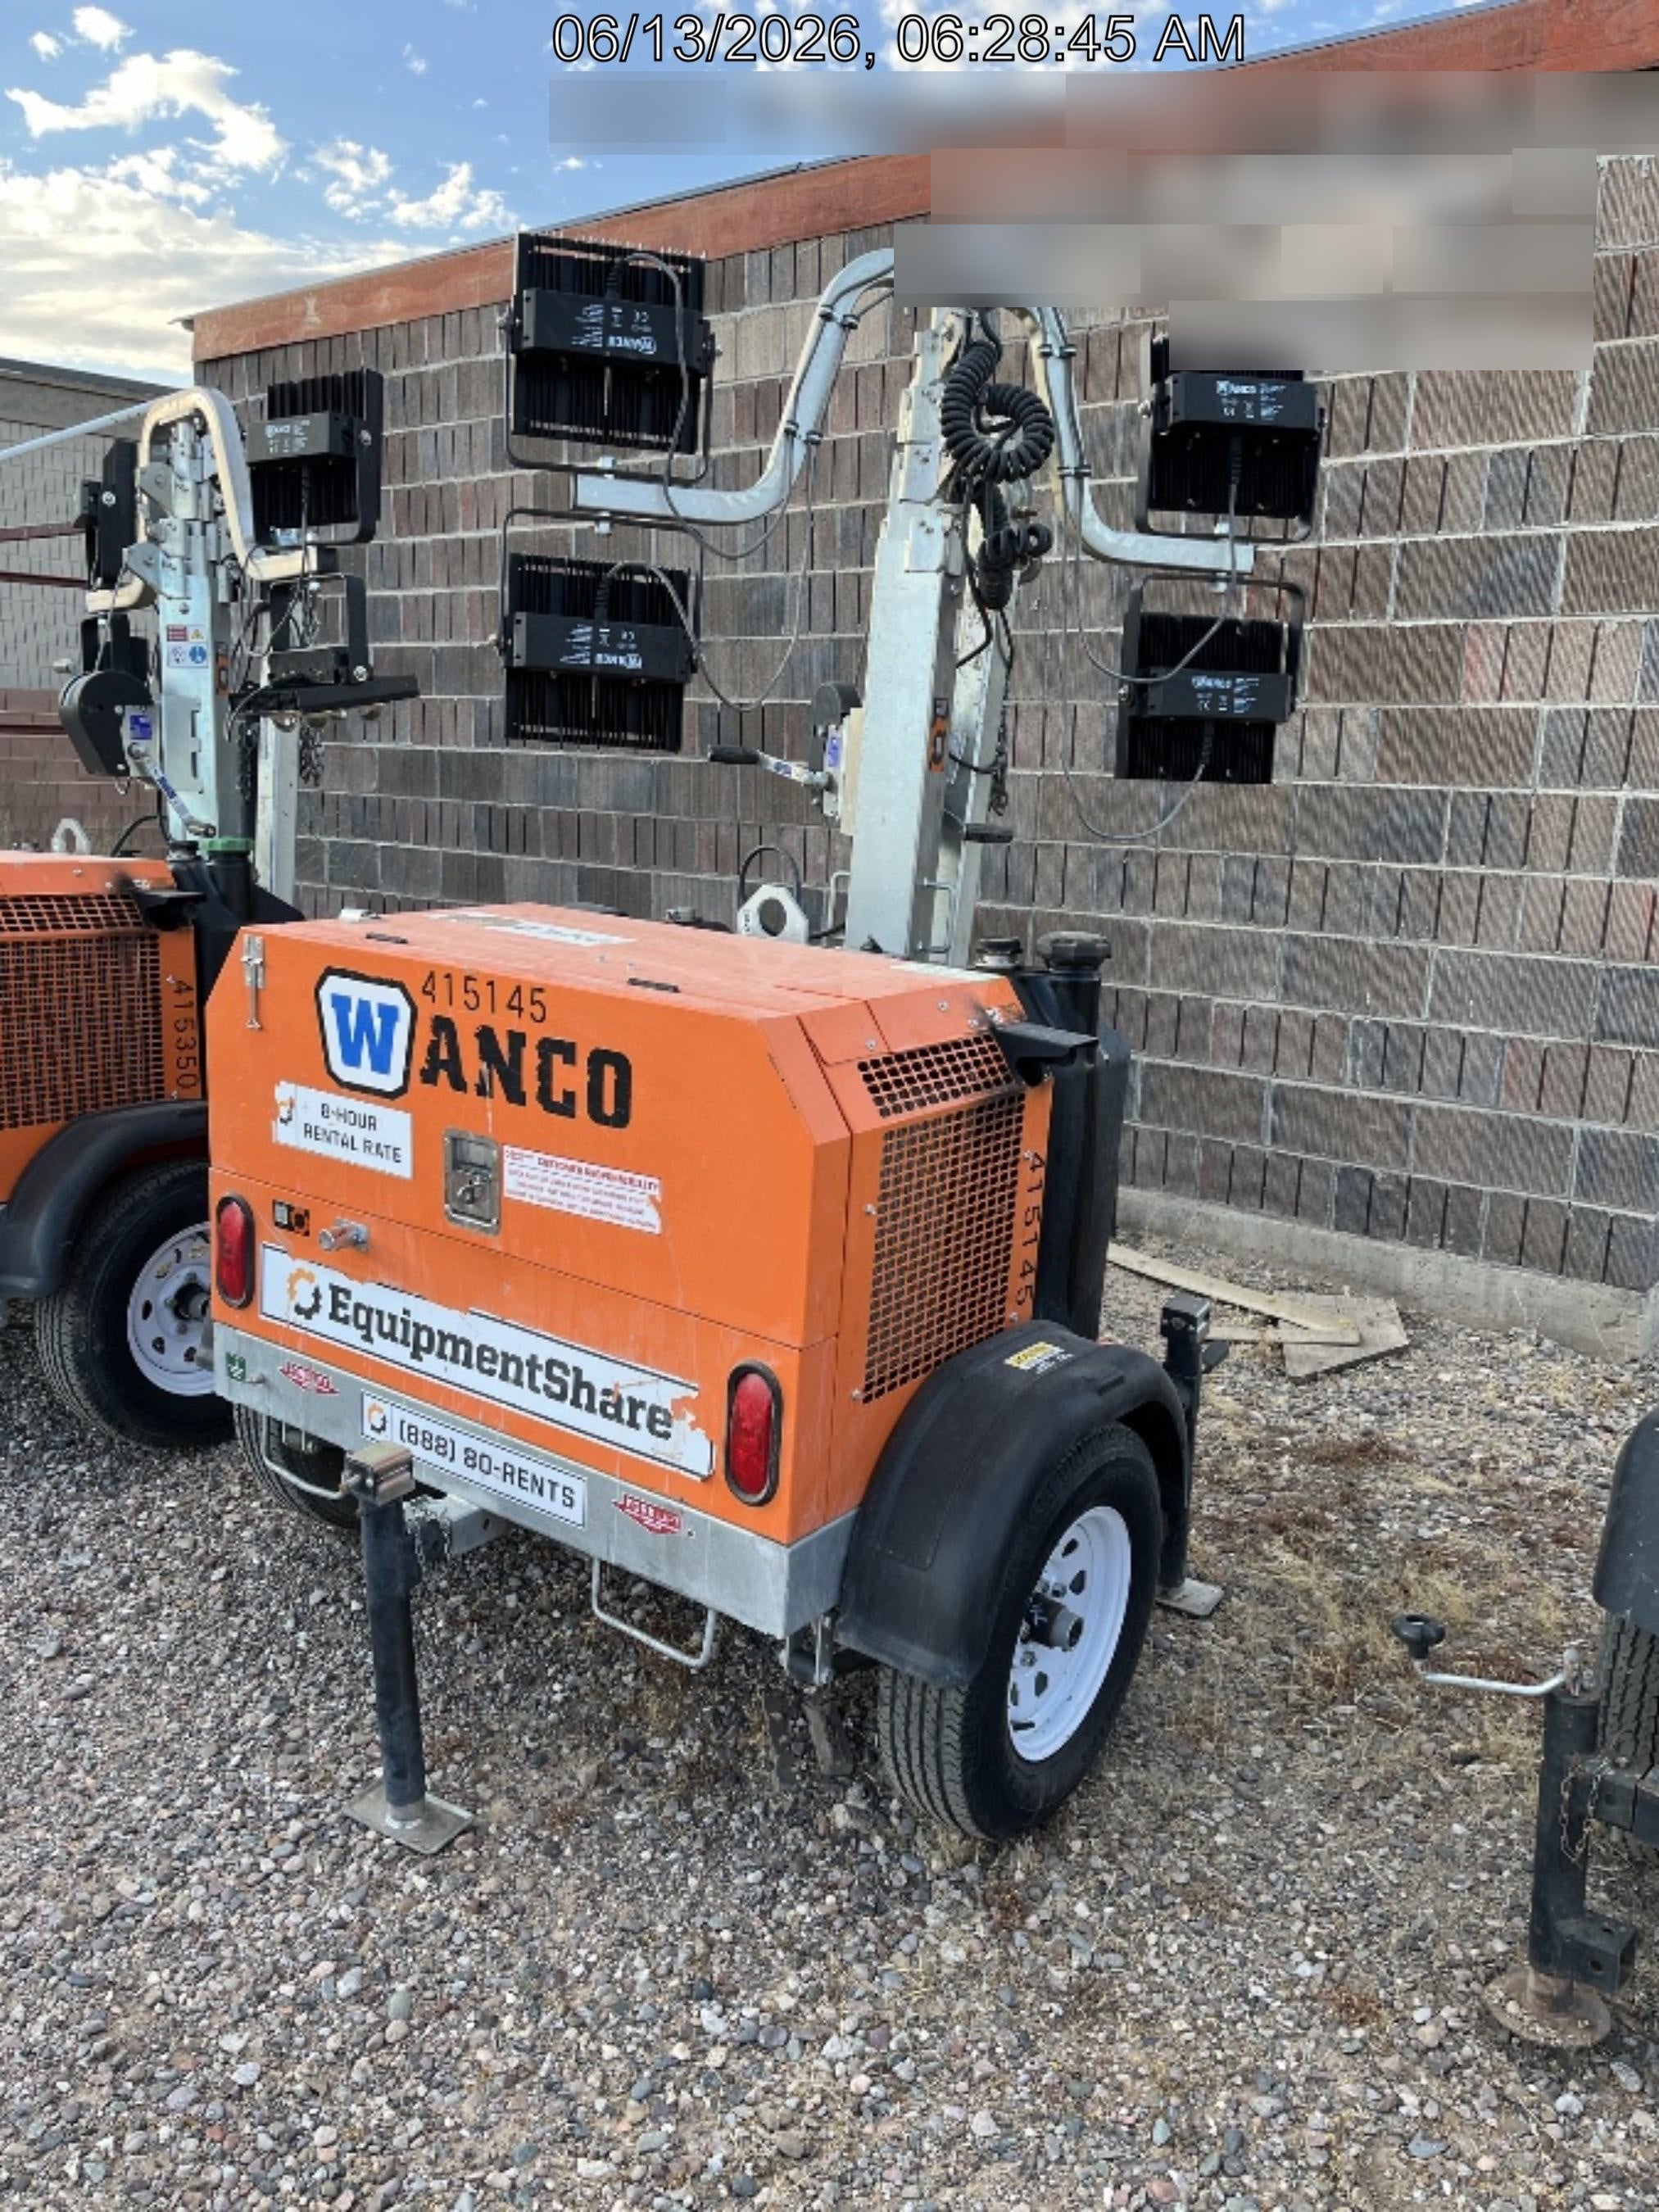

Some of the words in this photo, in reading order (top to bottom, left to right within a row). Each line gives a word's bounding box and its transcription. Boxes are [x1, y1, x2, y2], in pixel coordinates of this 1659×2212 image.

[173, 979, 198, 1090] 415350
[421, 970, 548, 1024] 415145
[330, 992, 633, 1129] WANCO
[303, 1122, 359, 1151] RENTAL
[362, 1139, 402, 1163] RATE
[1016, 1151, 1046, 1306] 415145
[328, 1282, 673, 1440] EquipmentShare
[399, 1419, 456, 1463] (888)
[463, 1446, 575, 1509] 80-RENTS
